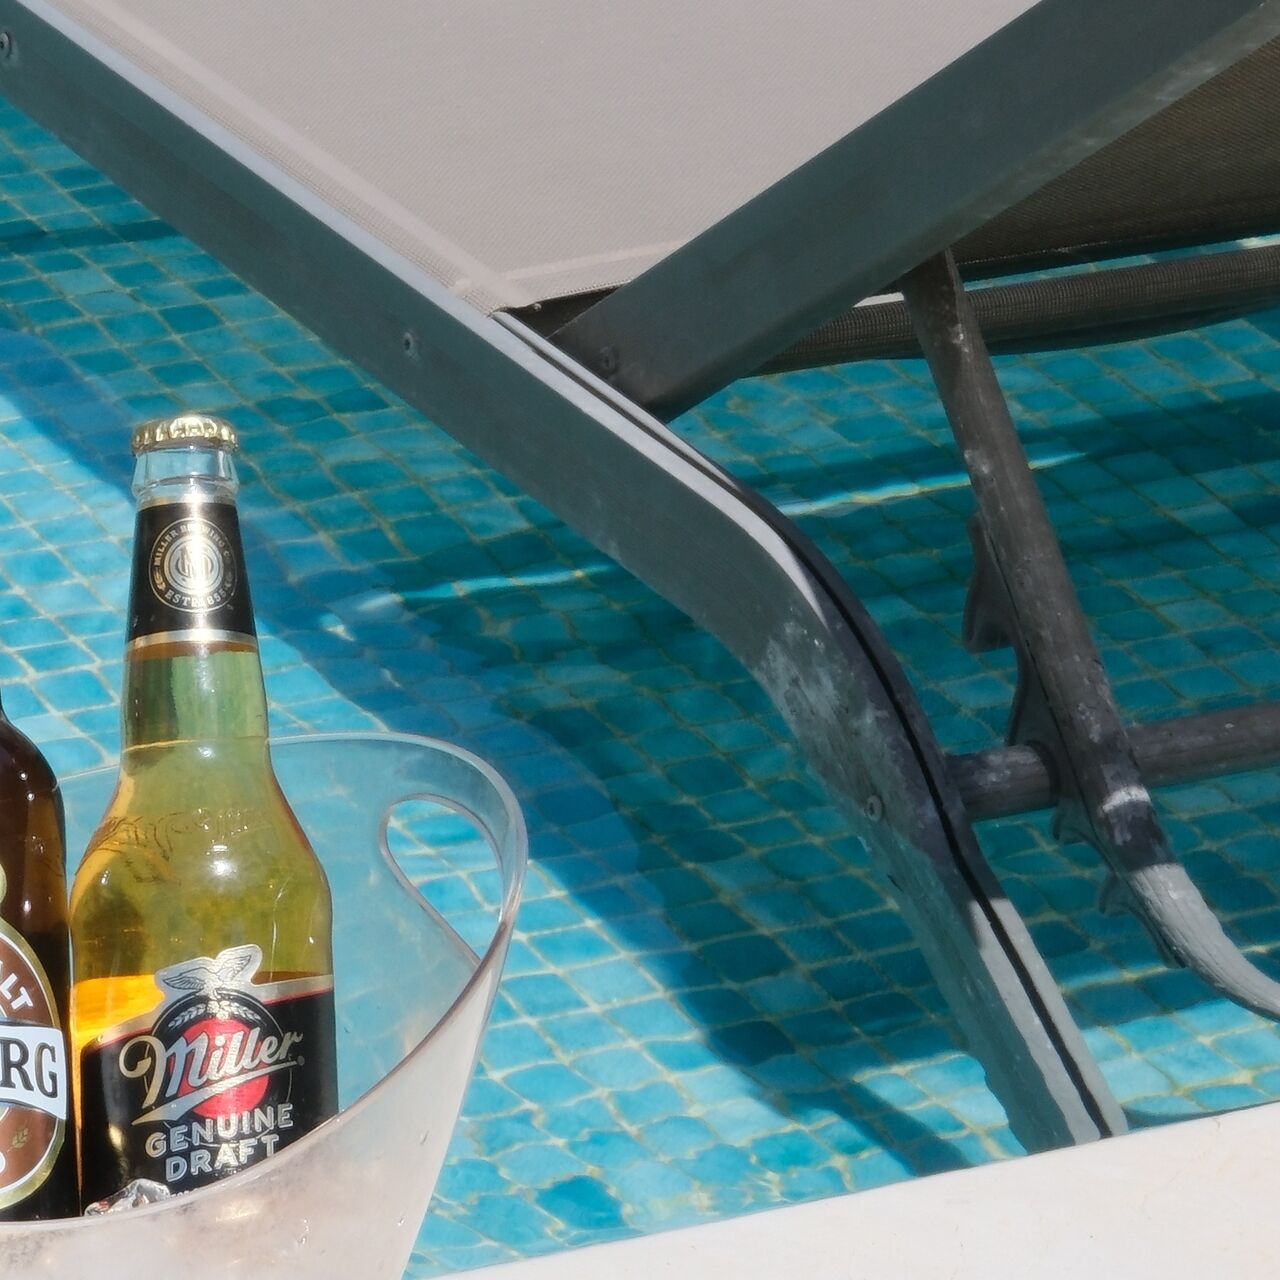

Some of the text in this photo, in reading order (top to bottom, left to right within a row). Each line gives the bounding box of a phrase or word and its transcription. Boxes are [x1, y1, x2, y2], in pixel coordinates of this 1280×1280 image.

[153, 529, 179, 567] MILLER
[119, 1027, 304, 1109] Miller
[145, 1101, 294, 1158] GENUINE
[165, 1133, 280, 1183] DRAFT
